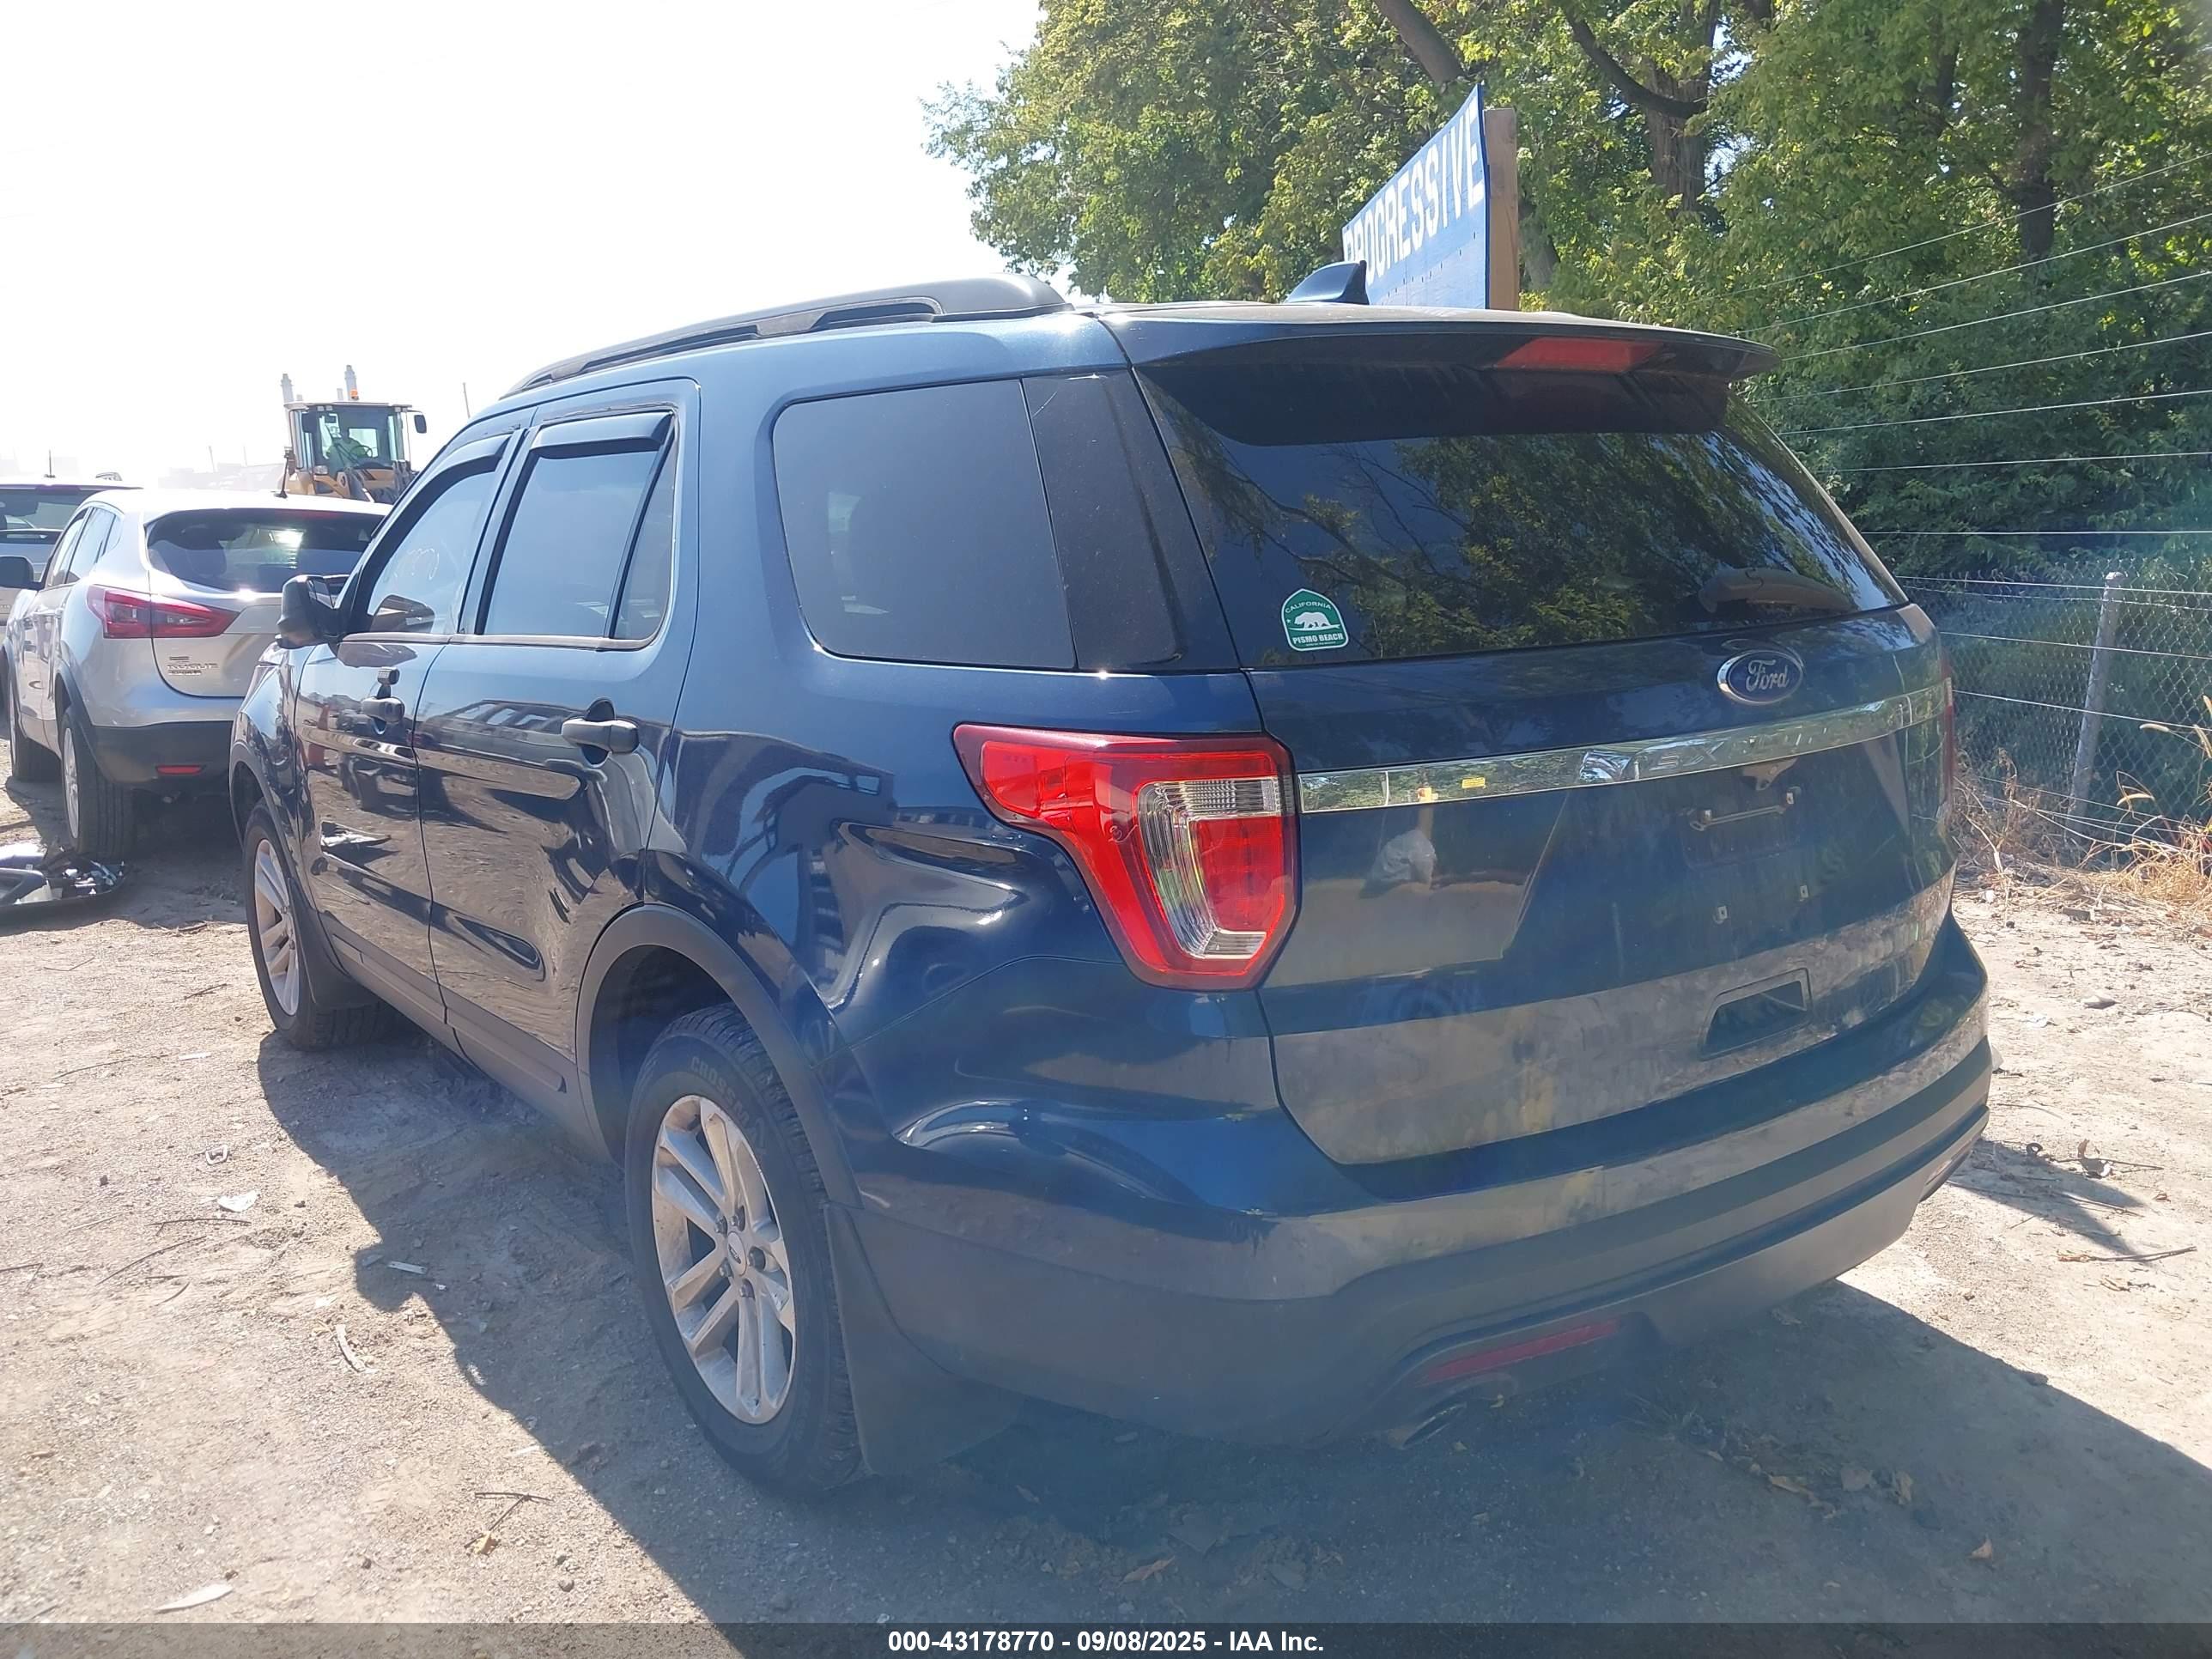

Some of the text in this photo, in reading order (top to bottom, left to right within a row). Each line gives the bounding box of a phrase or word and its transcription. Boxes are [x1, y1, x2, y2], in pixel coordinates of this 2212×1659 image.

[1344, 94, 1485, 285] PROGRESSIVE
[1285, 601, 1332, 613] CALIFORNIA
[1292, 635, 1318, 644] PISMO
[1318, 633, 1344, 641] BEACH
[1746, 659, 1790, 692] Ford
